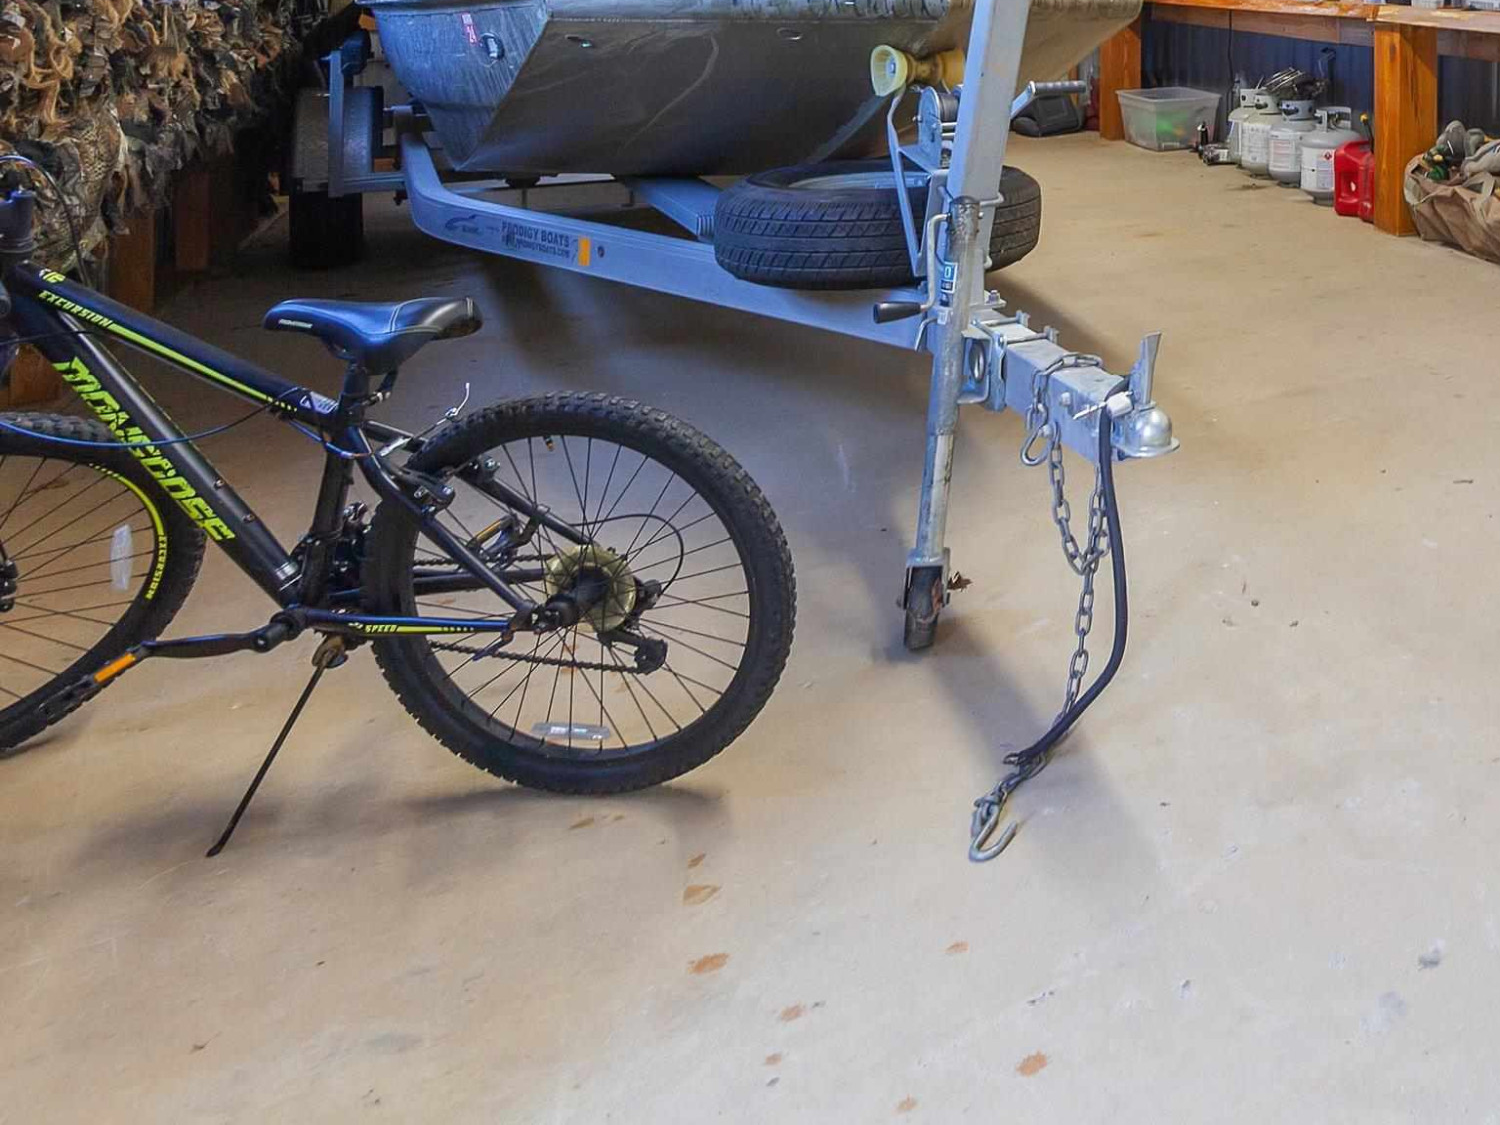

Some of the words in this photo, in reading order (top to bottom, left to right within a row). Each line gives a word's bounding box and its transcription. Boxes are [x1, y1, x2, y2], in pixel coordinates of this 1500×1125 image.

[501, 221, 540, 240] PRODIGY
[541, 229, 570, 248] BOATS
[38, 289, 113, 328] EXCURSION
[52, 356, 236, 541] MONGOOSE
[365, 624, 397, 633] SPEED
